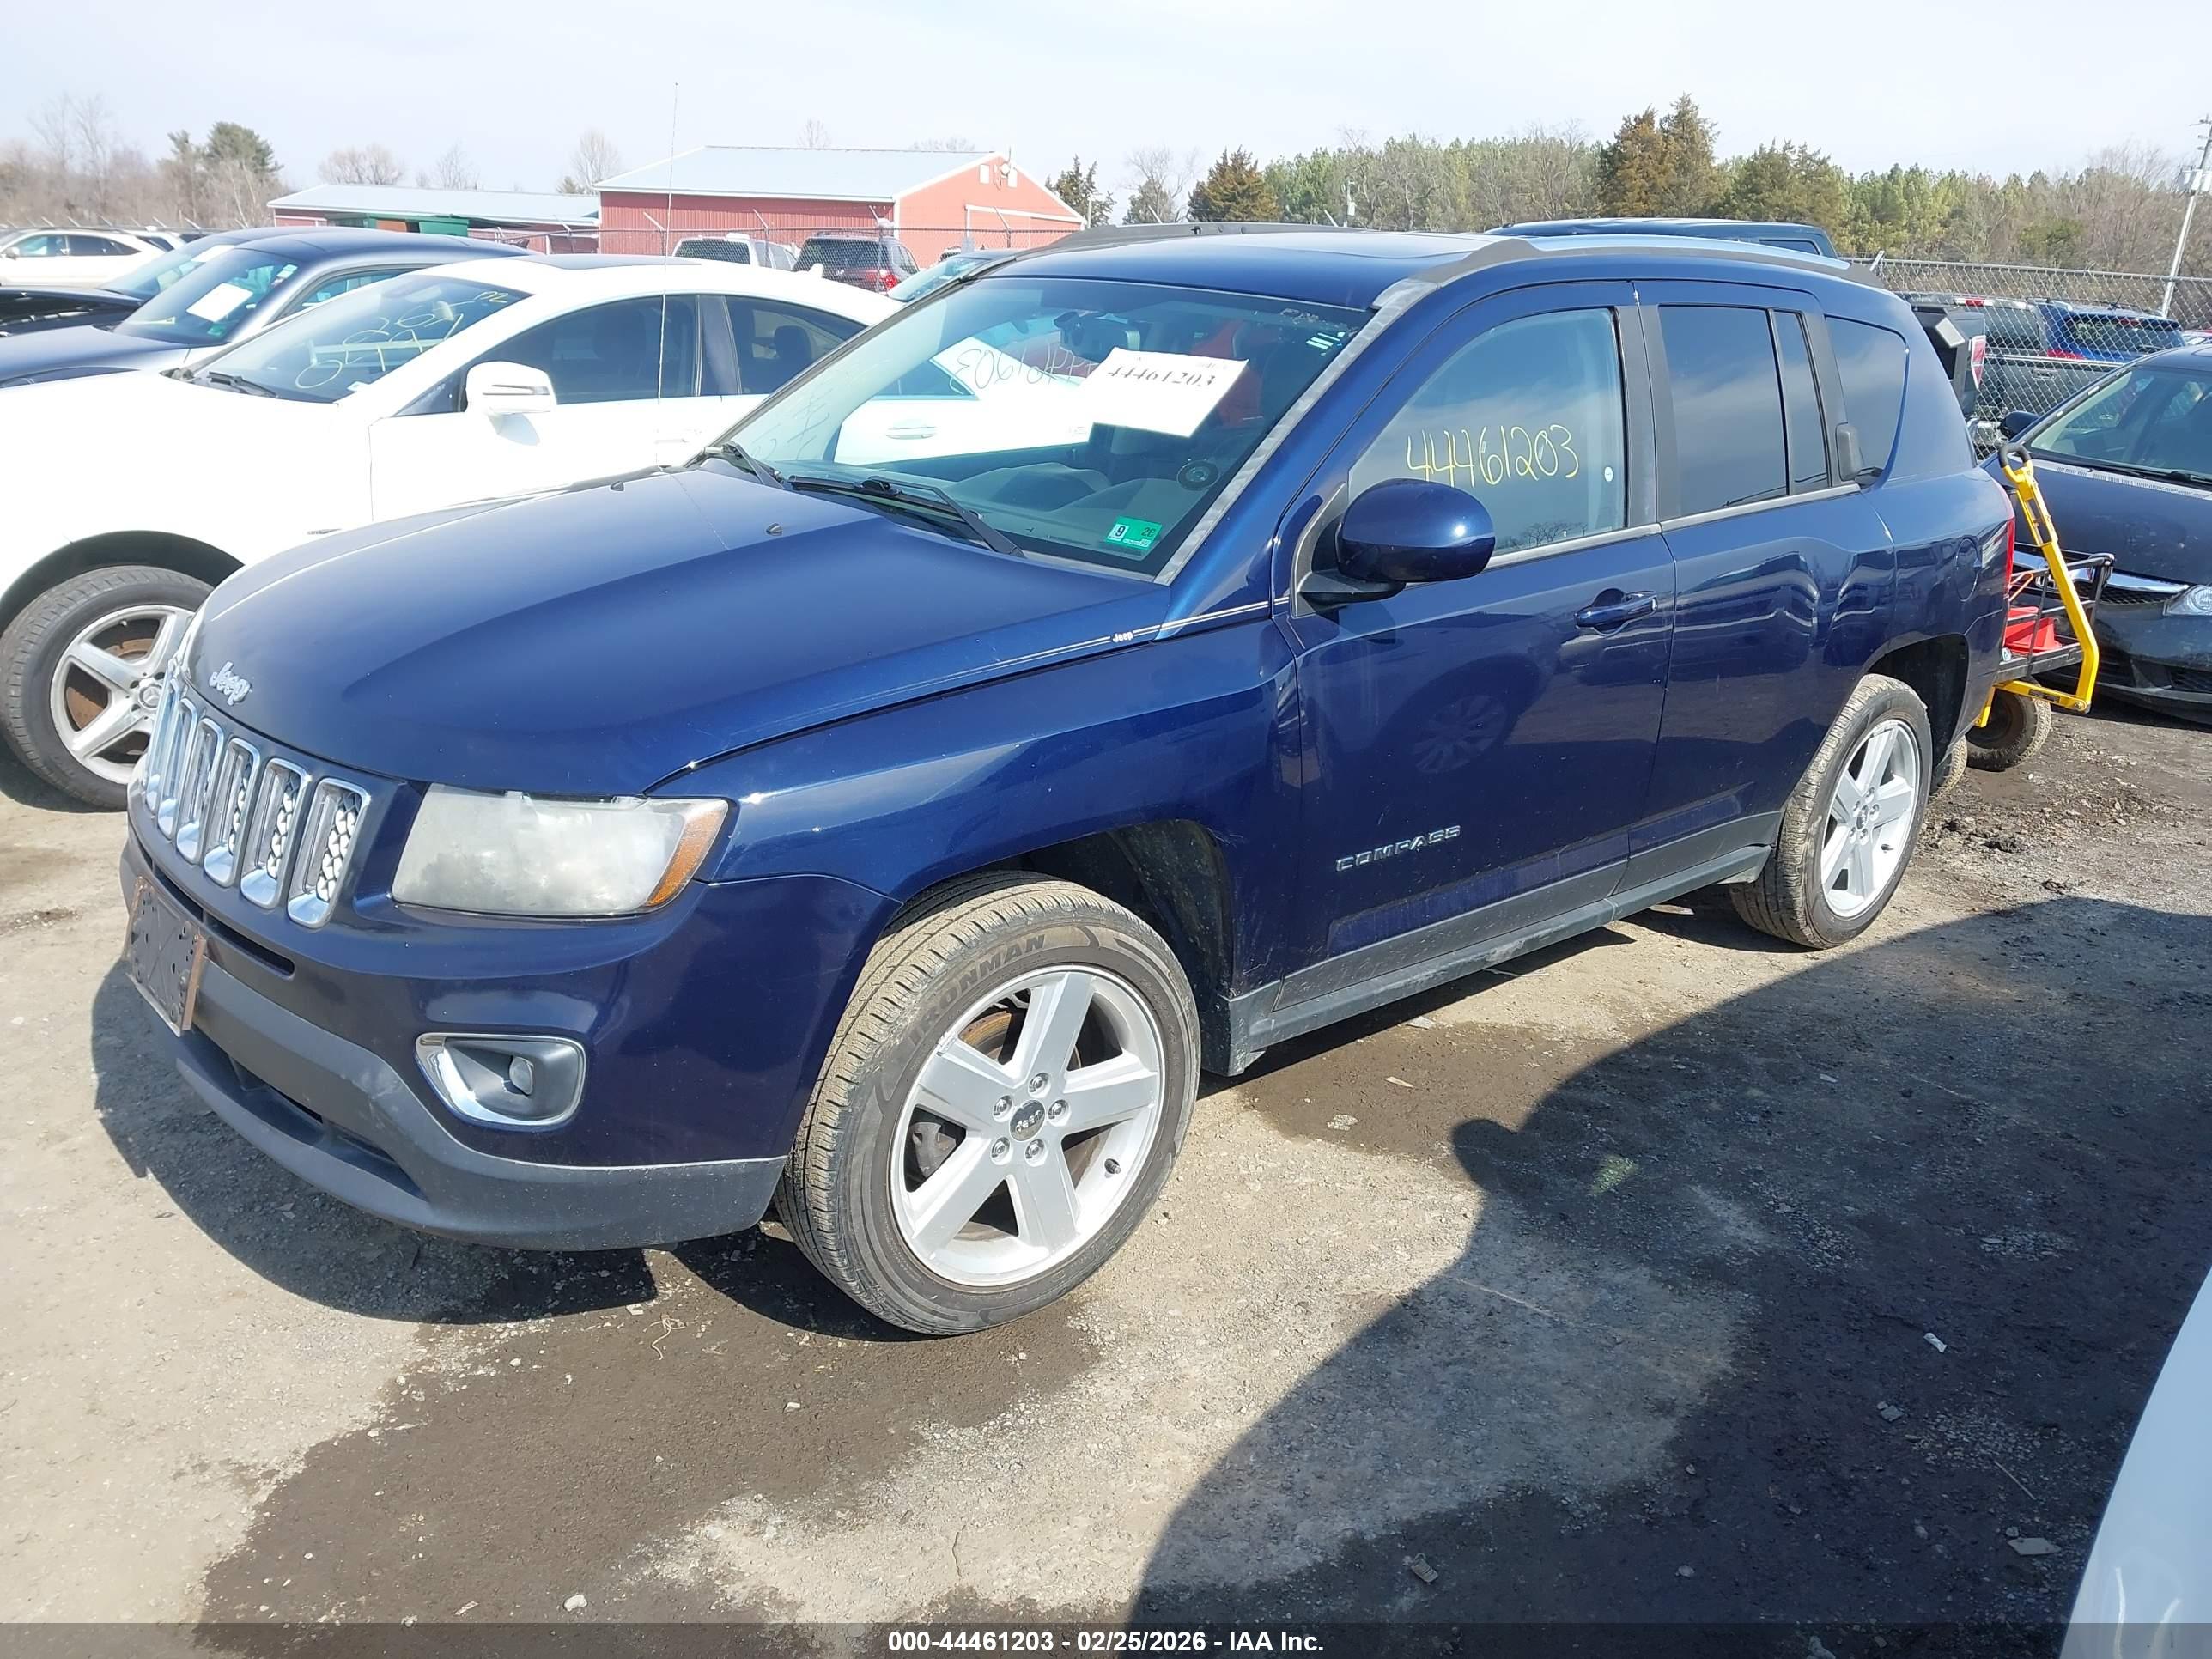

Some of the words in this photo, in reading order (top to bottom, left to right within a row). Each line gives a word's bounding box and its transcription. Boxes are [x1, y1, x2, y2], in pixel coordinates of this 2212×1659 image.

[1107, 366, 1216, 387] 44461203
[1406, 424, 1580, 489] 44461203
[1112, 631, 1134, 643] Jeep
[209, 661, 251, 705] Jeep
[1336, 825, 1461, 872] COMPASS
